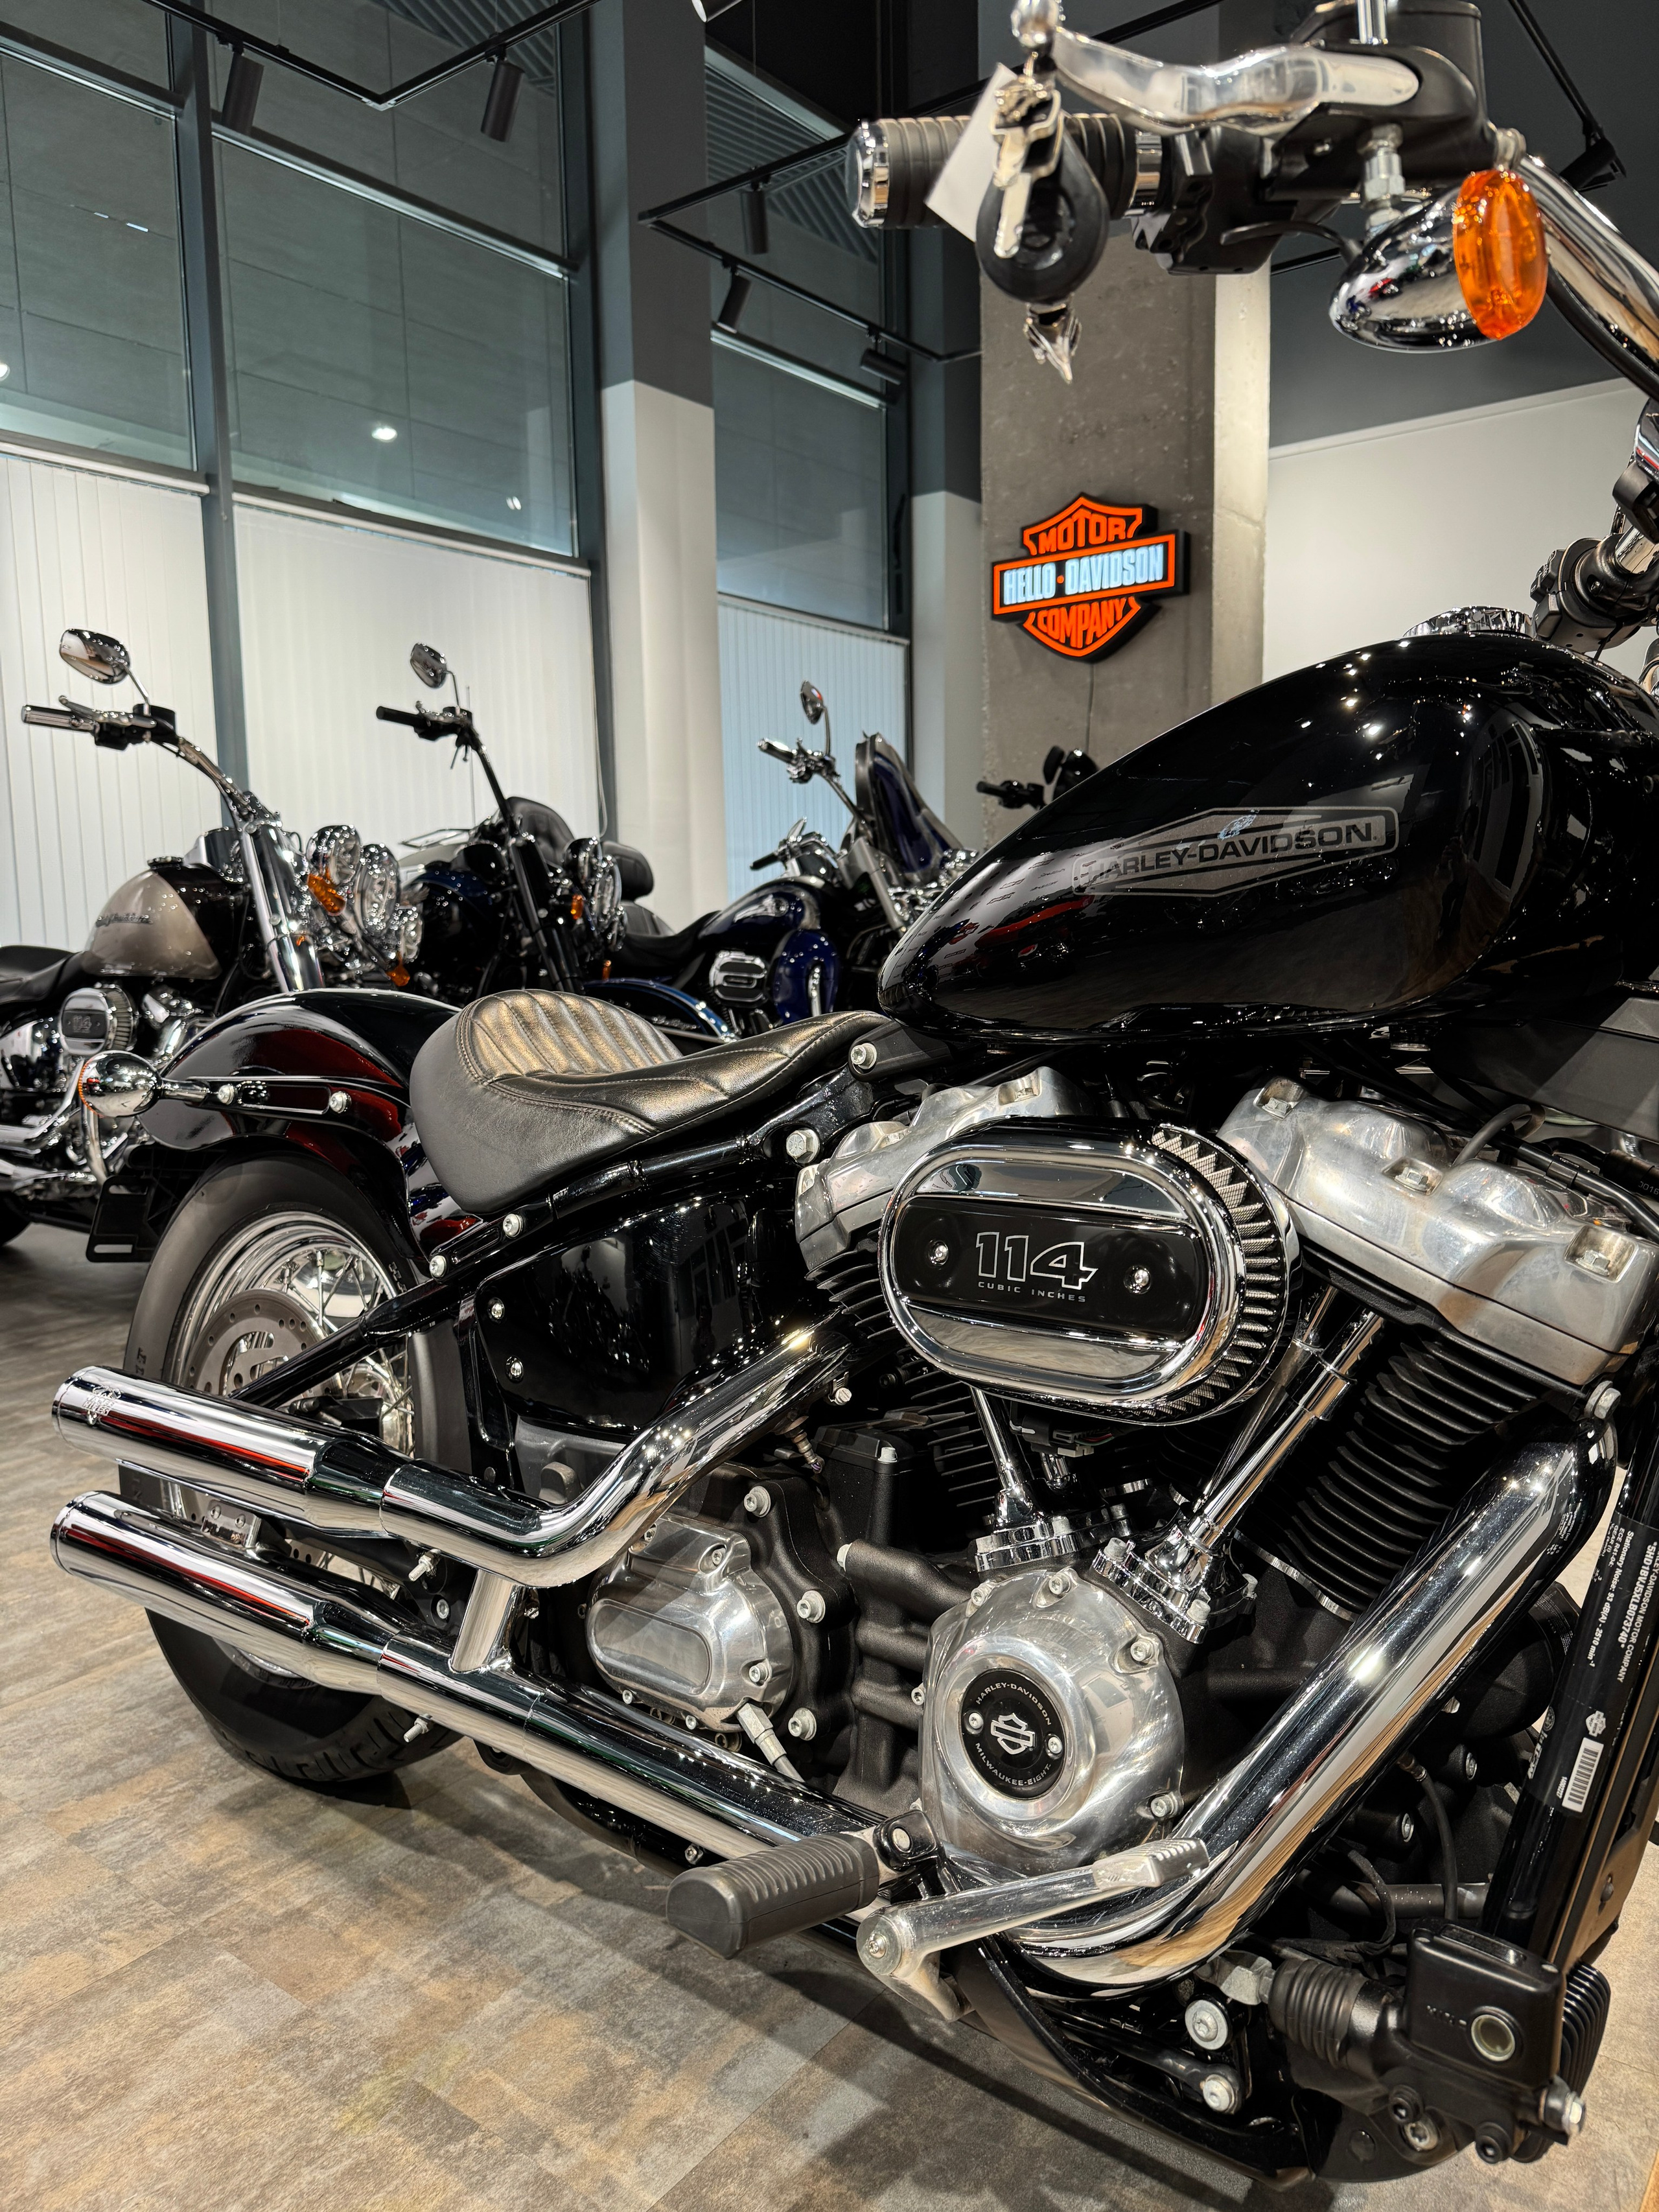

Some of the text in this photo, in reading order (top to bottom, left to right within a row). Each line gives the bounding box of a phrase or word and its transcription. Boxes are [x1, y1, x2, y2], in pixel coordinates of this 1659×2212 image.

[1038, 507, 1126, 554] MOTOR
[1004, 543, 1164, 605] HELLO DAVIDSON
[1037, 597, 1126, 649] COMPANY
[976, 1231, 1098, 1290] 114
[978, 1281, 1086, 1303] CUBIC INCHES
[1609, 1525, 1618, 1544] GEAR
[1616, 1528, 1625, 1543] ECE
[1616, 1530, 1634, 1568] Stationary
[1608, 1543, 1620, 1567] R41-04:
[1609, 1568, 1623, 1591] Noise:
[1607, 1592, 1615, 1602] 93
[1598, 1602, 1610, 1623] dB(A)
[1592, 1627, 1603, 1646] 2510
[1629, 1614, 1644, 1644] MOTOR
[1617, 1644, 1634, 1682] COMPANY
[976, 1682, 1051, 1725] HARLEY-DAVIDSON
[975, 1743, 1050, 1786] MILWAUKEE-EIGHT
